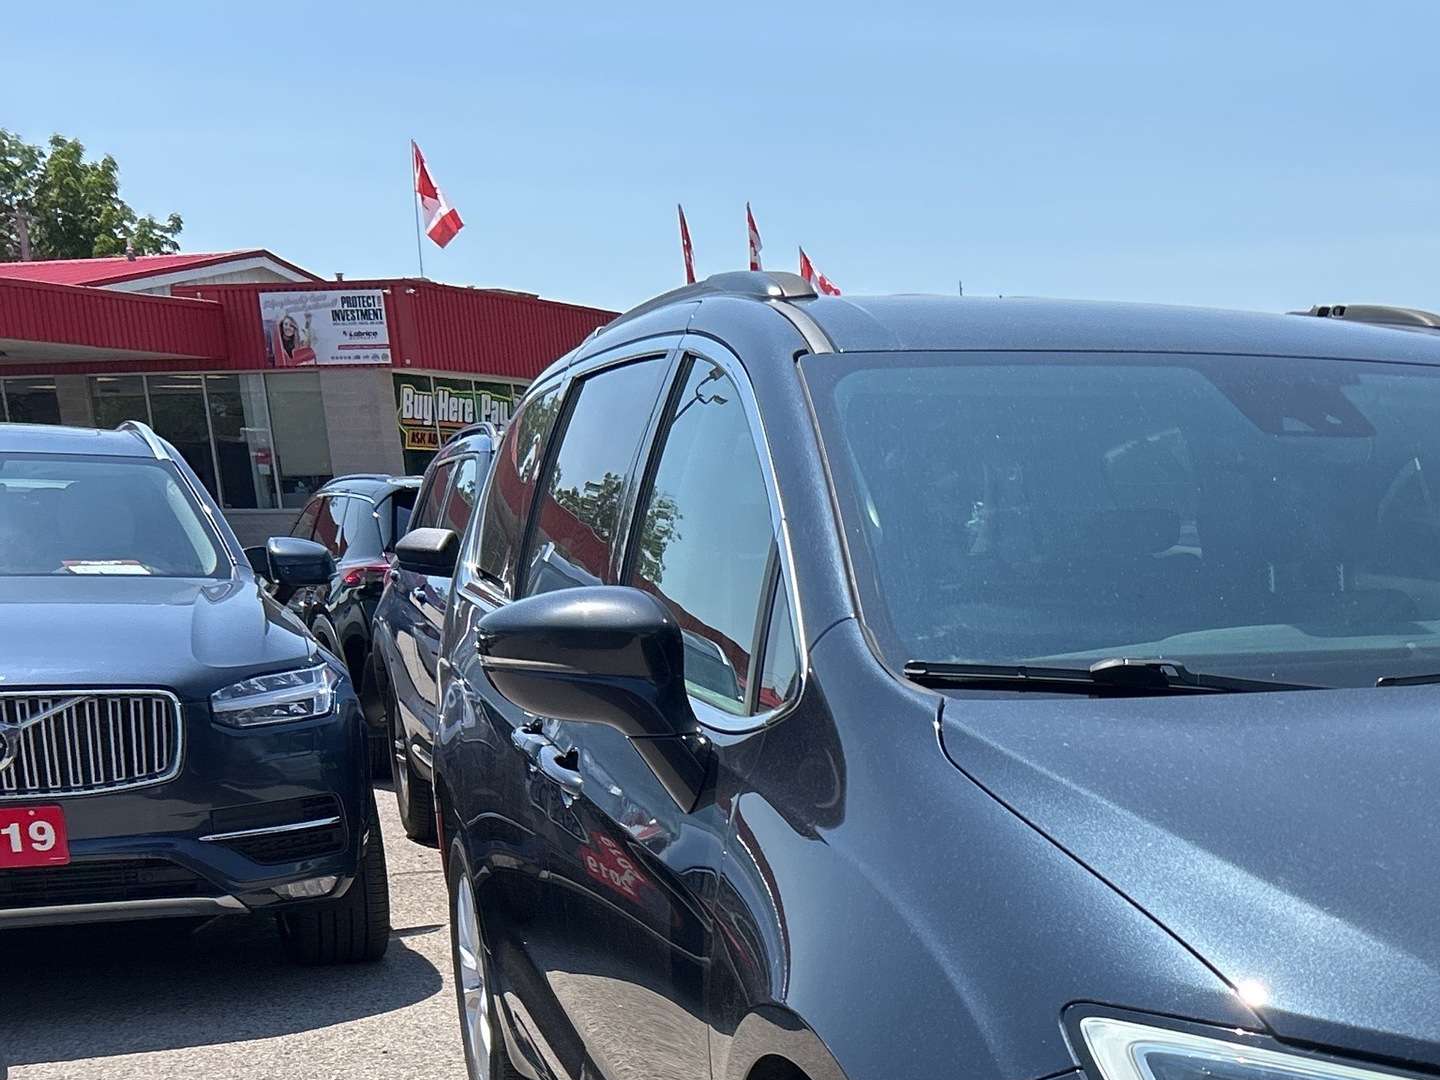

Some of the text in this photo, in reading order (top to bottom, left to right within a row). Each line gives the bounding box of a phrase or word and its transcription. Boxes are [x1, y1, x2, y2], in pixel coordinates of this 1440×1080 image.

[341, 295, 376, 308] PROTECT
[331, 308, 383, 321] INVESTMENT
[402, 387, 511, 433] Buy Here Pay
[0, 820, 56, 853] 19
